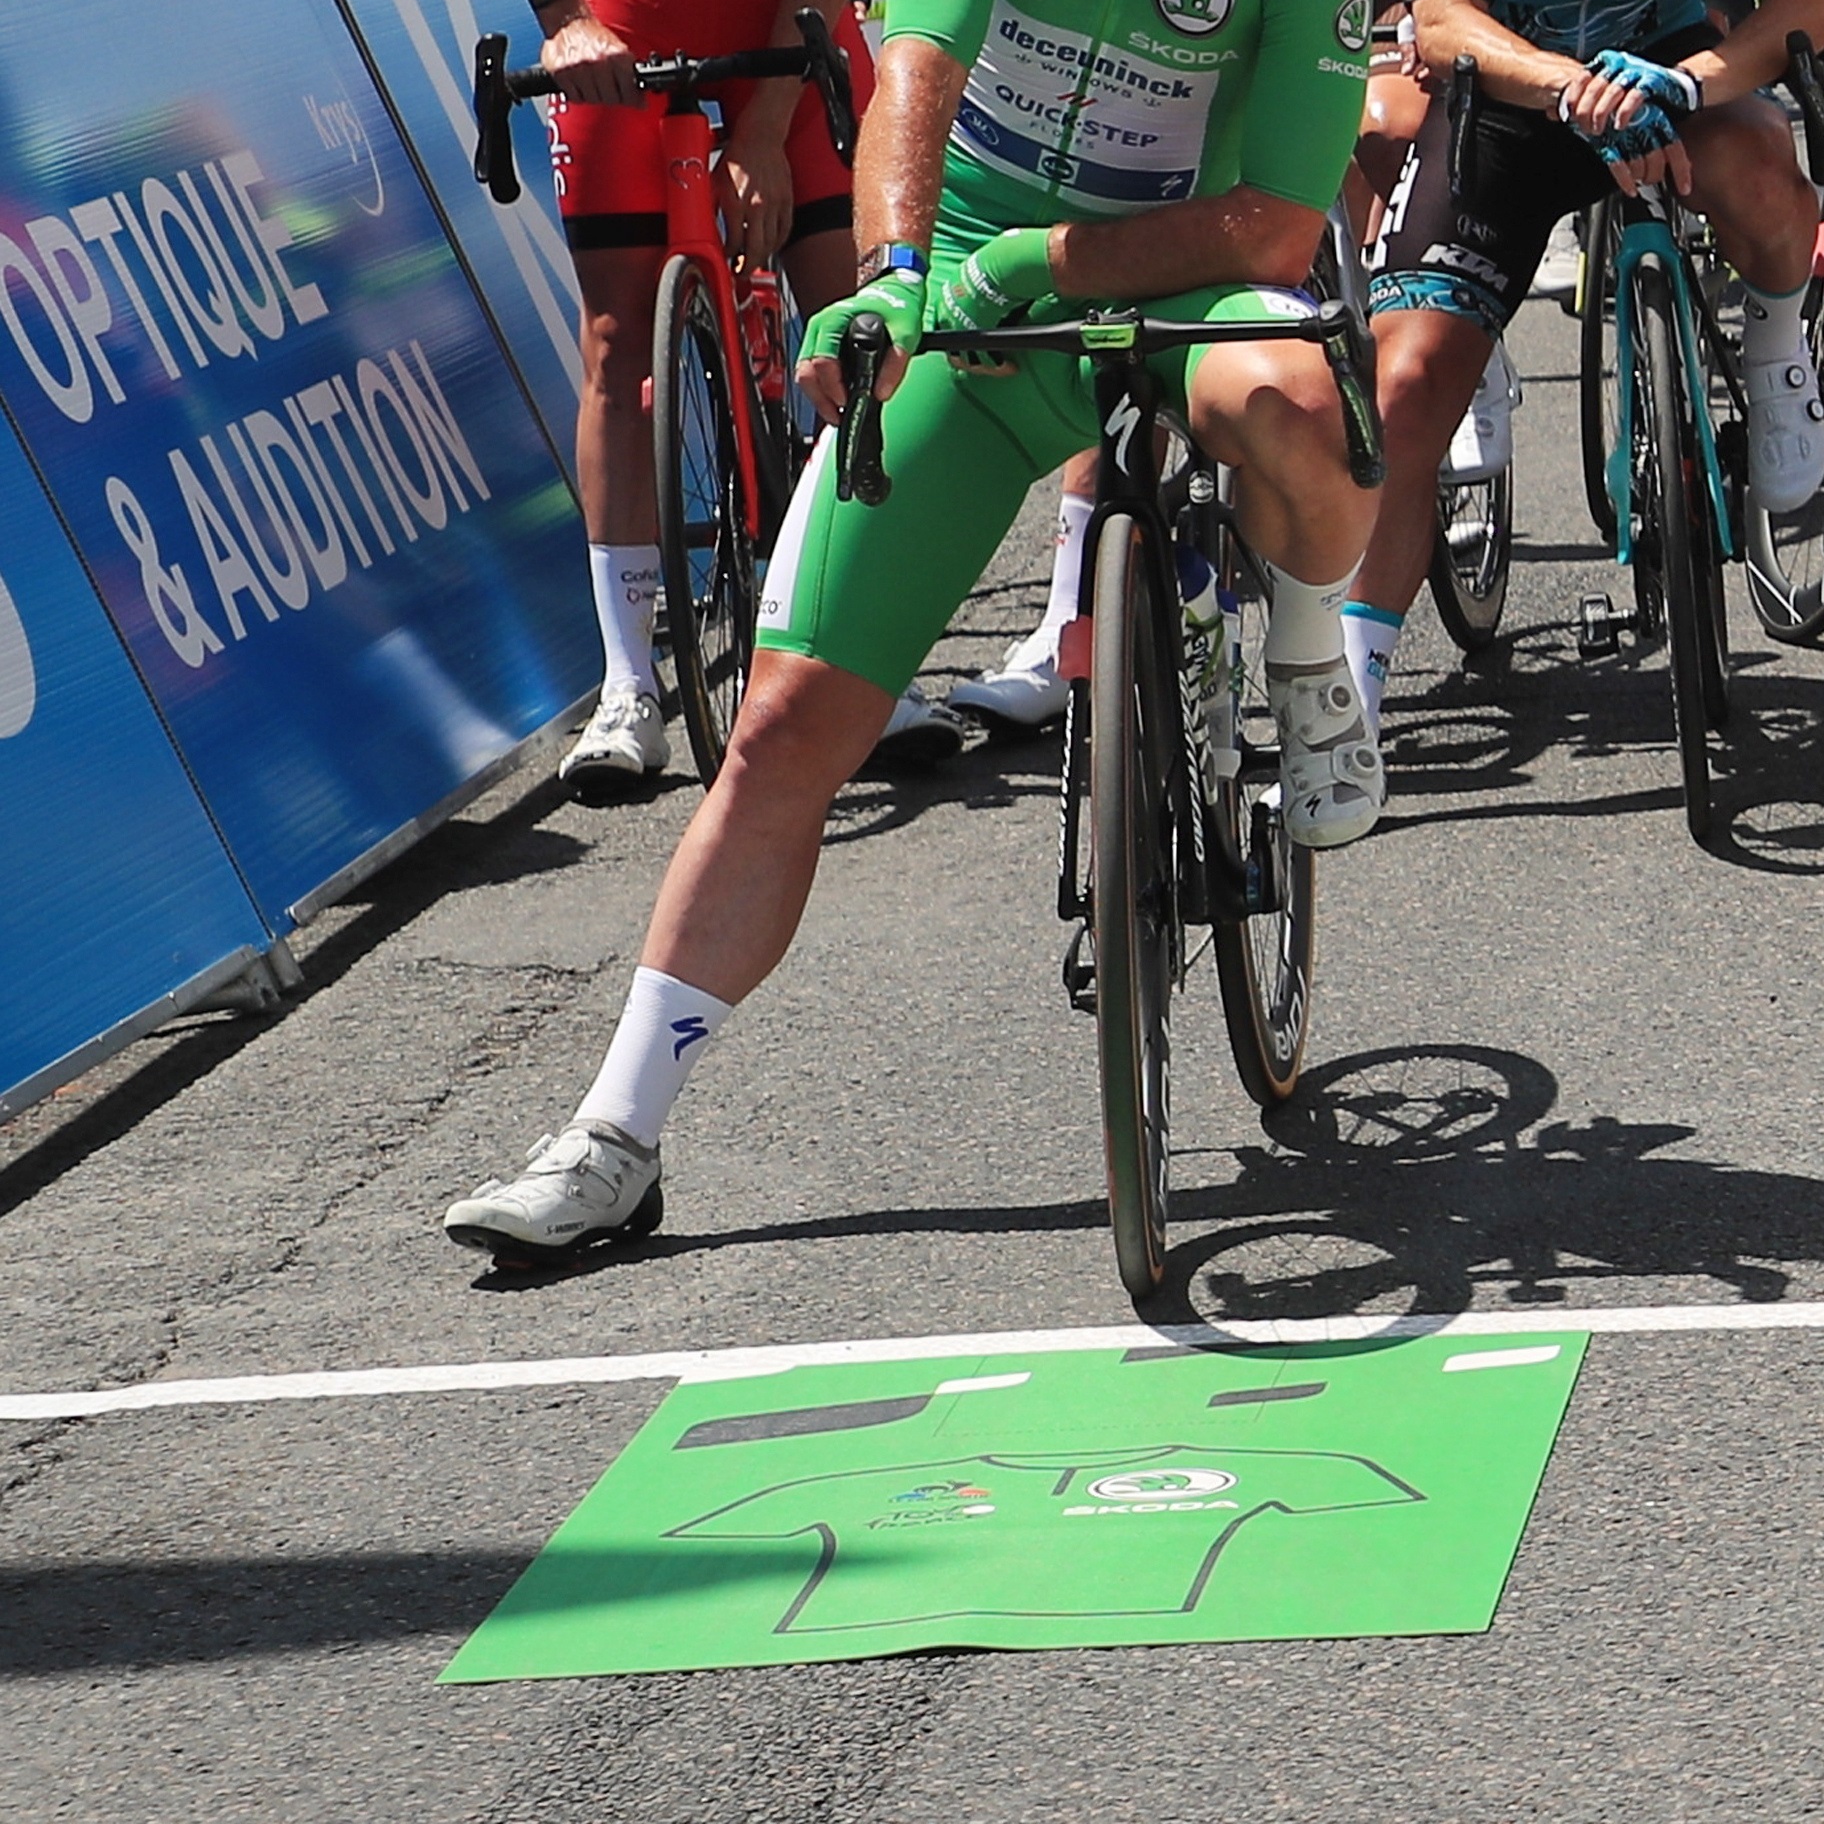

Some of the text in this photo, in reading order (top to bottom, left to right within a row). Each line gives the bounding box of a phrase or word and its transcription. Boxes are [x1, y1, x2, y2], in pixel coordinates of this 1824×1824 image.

[0, 150, 329, 425] OPTIQUE
[106, 476, 226, 671] &
[168, 339, 491, 643] AUDITION
